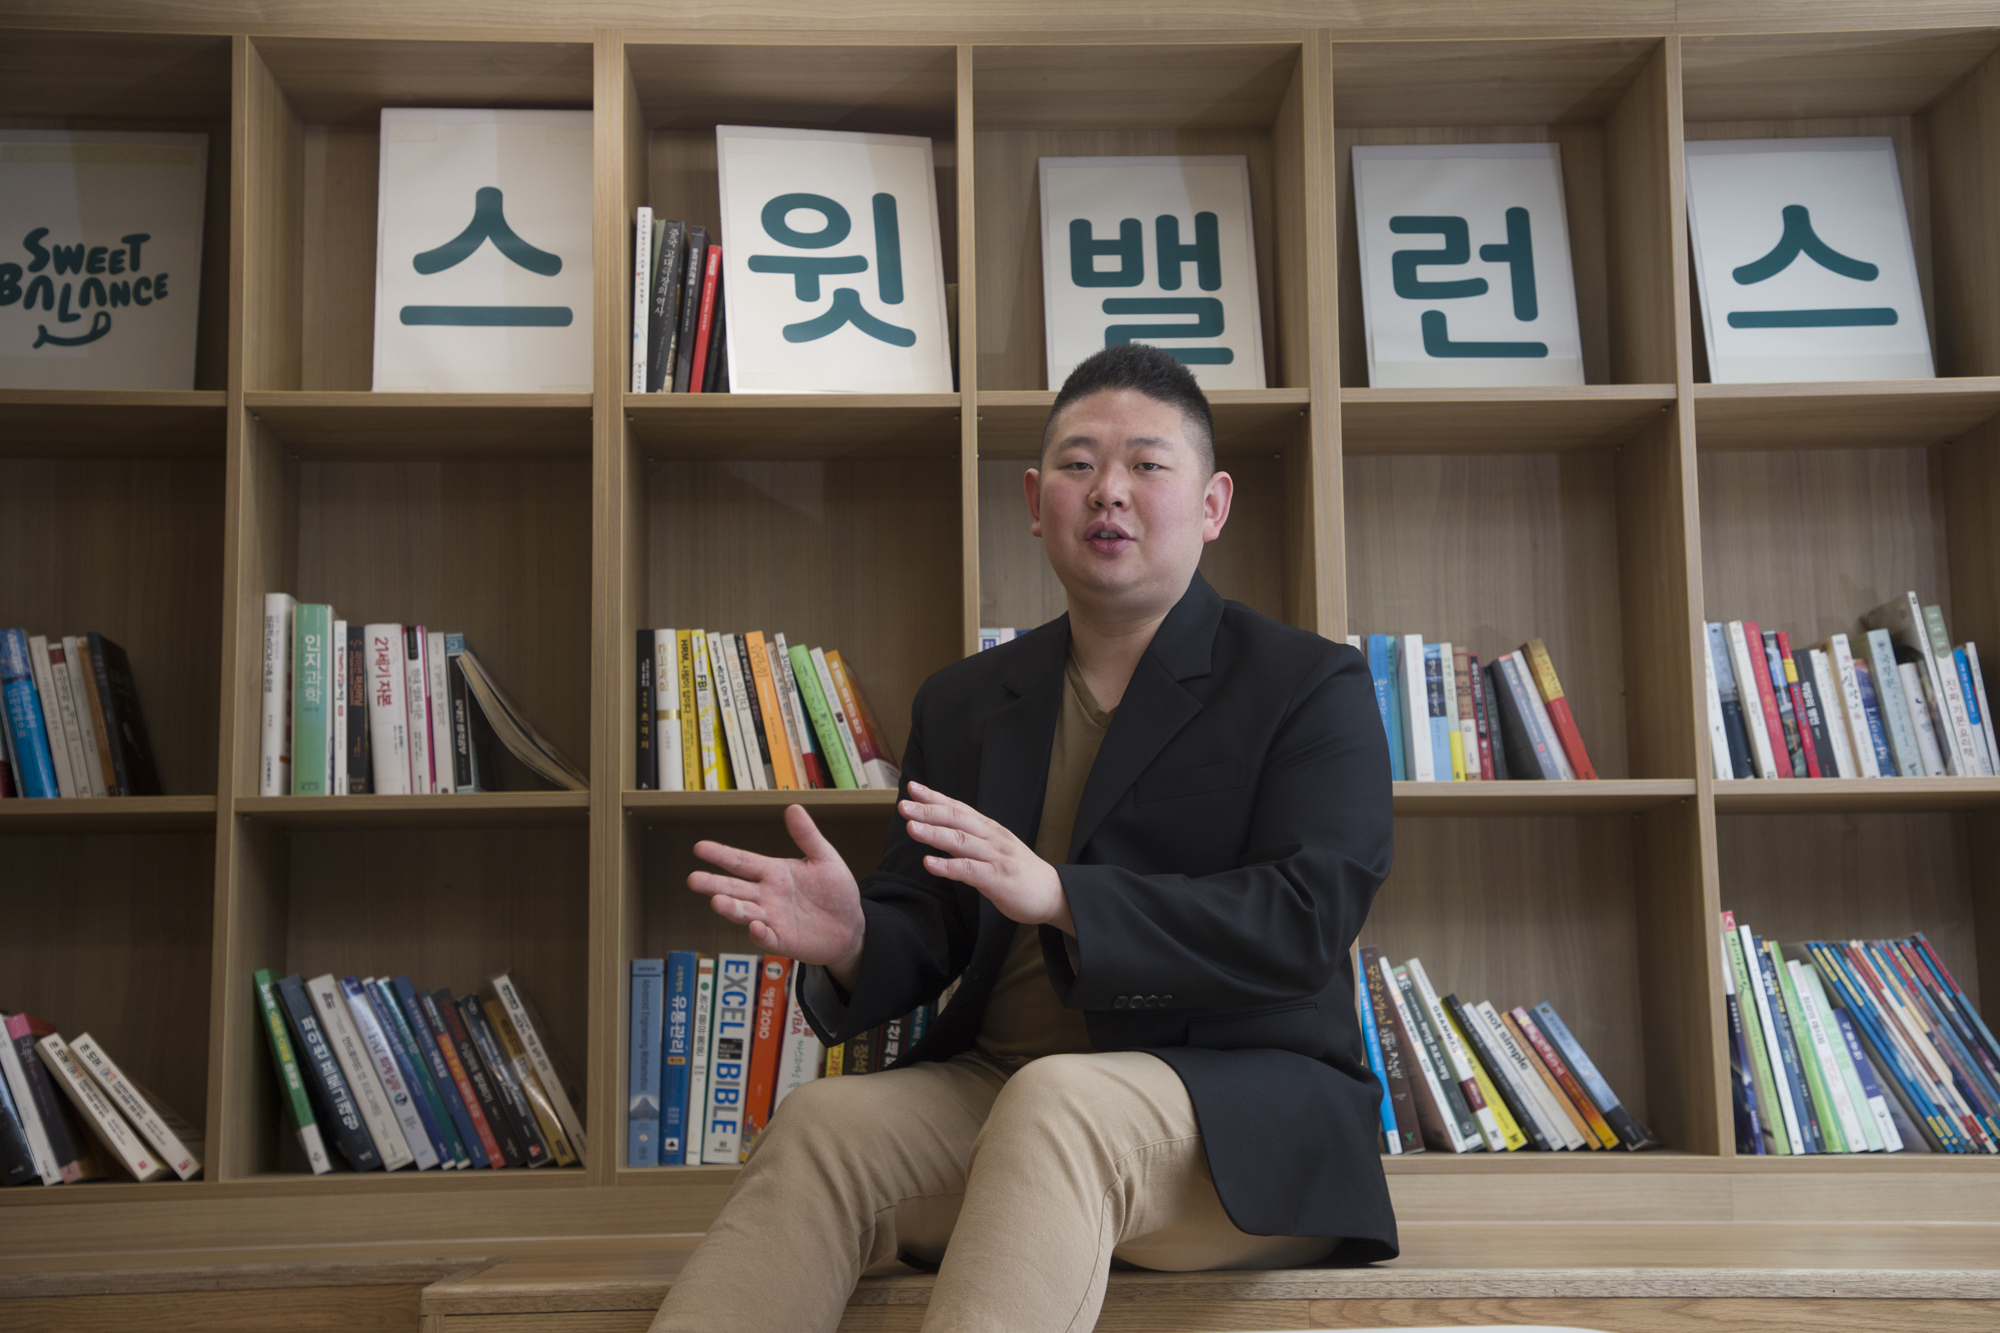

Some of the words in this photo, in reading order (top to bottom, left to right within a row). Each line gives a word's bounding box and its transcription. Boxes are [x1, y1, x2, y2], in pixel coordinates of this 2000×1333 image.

[23, 227, 150, 274] SWEET
[400, 186, 573, 327] 스
[747, 192, 917, 348] 윗
[1727, 204, 1899, 329] 스
[0, 263, 169, 322] BALANCE
[1069, 211, 1234, 365] 밸
[1389, 207, 1549, 358] 런
[305, 634, 321, 704] 인지과학
[374, 636, 391, 678] 21세기
[681, 664, 691, 689] 사람이
[376, 680, 393, 707] 자본
[683, 689, 693, 714] 답이다
[697, 674, 708, 692] FBI
[1865, 707, 1879, 734] Life
[1872, 733, 1882, 748] of
[1875, 746, 1888, 760] Pi
[642, 979, 651, 1012] Advanced
[719, 959, 750, 1034] EXCEL
[762, 986, 776, 1008] 엑셀
[301, 1015, 331, 1061] 파이썬
[640, 1011, 650, 1050] Engineering
[669, 995, 687, 1053] 유통관리
[758, 1009, 774, 1040] 2010
[1433, 1005, 1458, 1054] GRAMMAR
[1485, 1010, 1502, 1031] not
[1499, 1030, 1528, 1071] simple
[342, 1035, 364, 1076] 안드로이드
[361, 1078, 382, 1117] 프로그래밍
[640, 1050, 650, 1091] Mathematics
[852, 1045, 869, 1073] 정석
[711, 1063, 742, 1135] BIBLE
